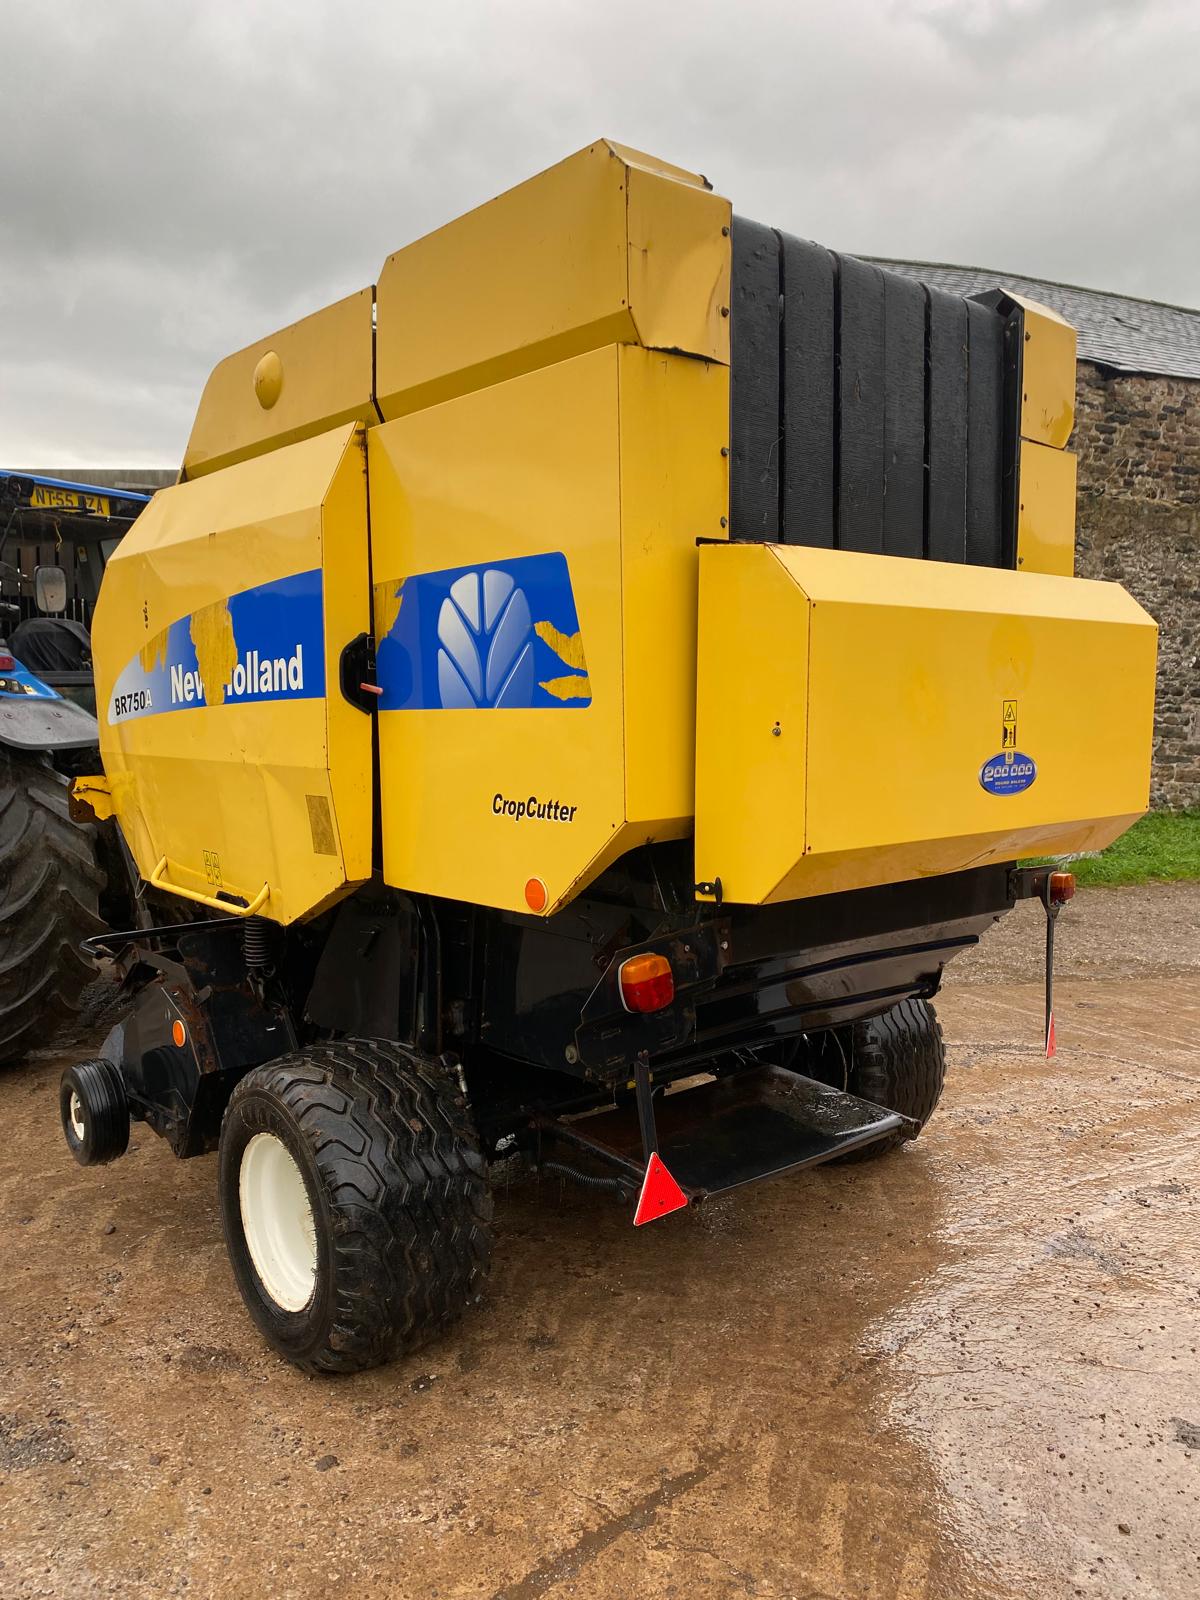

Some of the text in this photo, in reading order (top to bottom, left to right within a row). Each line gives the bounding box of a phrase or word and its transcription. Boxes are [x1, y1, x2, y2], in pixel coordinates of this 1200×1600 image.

[35, 485, 75, 507] NT55
[226, 644, 304, 696] olland
[114, 688, 153, 716] BR750A
[984, 764, 1033, 782] 200 000
[492, 793, 578, 822] CropCutter
